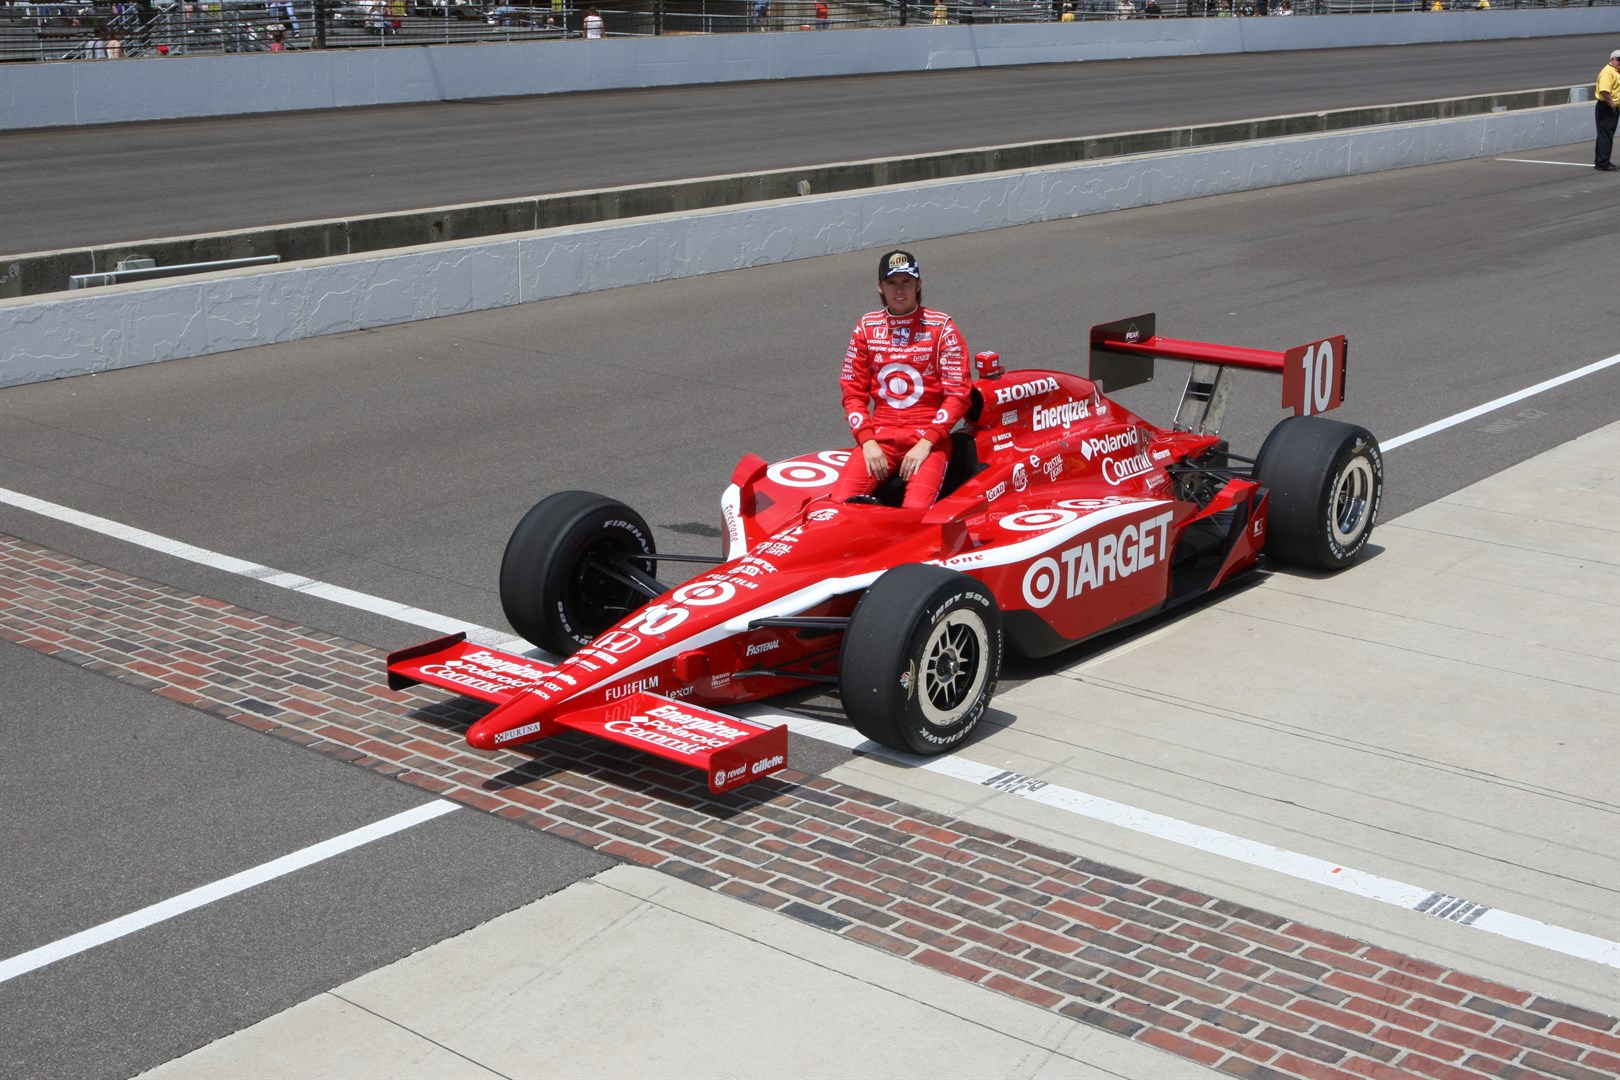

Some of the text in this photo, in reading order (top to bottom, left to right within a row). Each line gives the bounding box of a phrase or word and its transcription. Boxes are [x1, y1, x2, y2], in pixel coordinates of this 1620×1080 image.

[890, 256, 907, 265] 500
[994, 377, 1060, 404] HONDA
[1302, 340, 1334, 416] 10
[1032, 397, 1092, 431] Energizer
[1089, 425, 1138, 457] Polaroid
[1102, 448, 1152, 486] Commit
[987, 484, 1005, 501] GLAD
[724, 504, 739, 542] Firestone
[1061, 510, 1174, 600] TARGET
[930, 591, 990, 625] INDY 500
[746, 640, 780, 656] FASTENAL
[419, 664, 515, 693] Commit
[457, 663, 534, 687] Polaroid
[460, 650, 547, 680] Energizer
[605, 675, 659, 702] FUJIFILM
[665, 685, 694, 699] Lexar
[504, 724, 539, 741] PURINA
[644, 704, 750, 740] Energizer
[644, 719, 730, 748] Polaroid
[918, 700, 985, 745] FIREHAWK
[604, 720, 712, 754] Commit
[727, 763, 747, 779] reveal
[752, 755, 784, 775] Gillette
